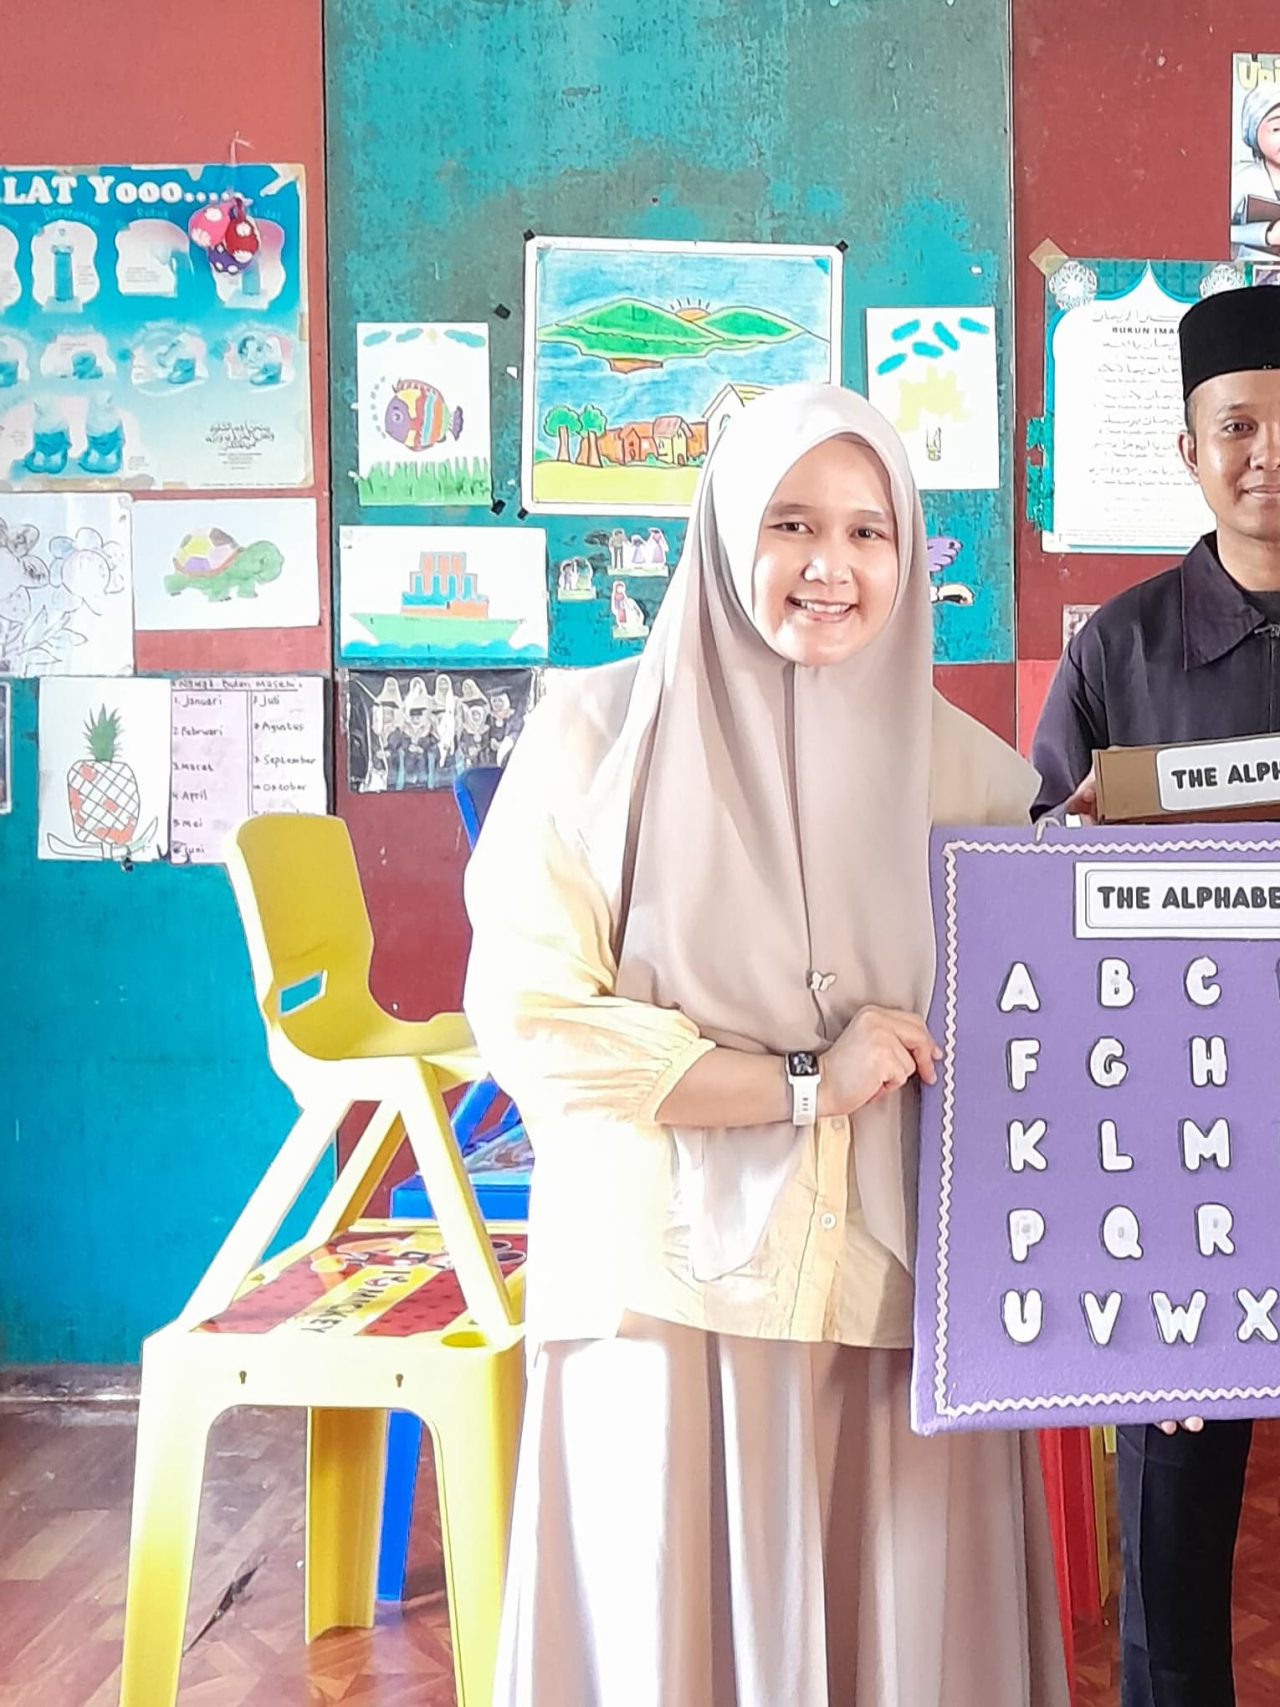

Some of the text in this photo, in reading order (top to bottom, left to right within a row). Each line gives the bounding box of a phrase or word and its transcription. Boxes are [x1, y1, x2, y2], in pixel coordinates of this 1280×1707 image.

[2, 175, 77, 204] LAT
[1112, 326, 1150, 334] RUKUN
[182, 789, 208, 803] April
[1171, 767, 1218, 789] THE
[1097, 885, 1151, 909] THE
[1000, 962, 1040, 1012] A
[1101, 959, 1134, 1007] B
[1185, 955, 1221, 1006] C
[1010, 1039, 1040, 1090] F
[1090, 1038, 1127, 1087] G
[1192, 1036, 1228, 1086] H
[1010, 1119, 1047, 1171] K
[1101, 1120, 1133, 1171] L
[1183, 1118, 1230, 1170] M
[1009, 1209, 1045, 1262] P
[1103, 1206, 1143, 1258] Q
[1197, 1204, 1234, 1256] R
[1003, 1289, 1043, 1345] U
[1081, 1291, 1122, 1345] V
[1149, 1291, 1207, 1344] W
[1234, 1288, 1279, 1341] X
